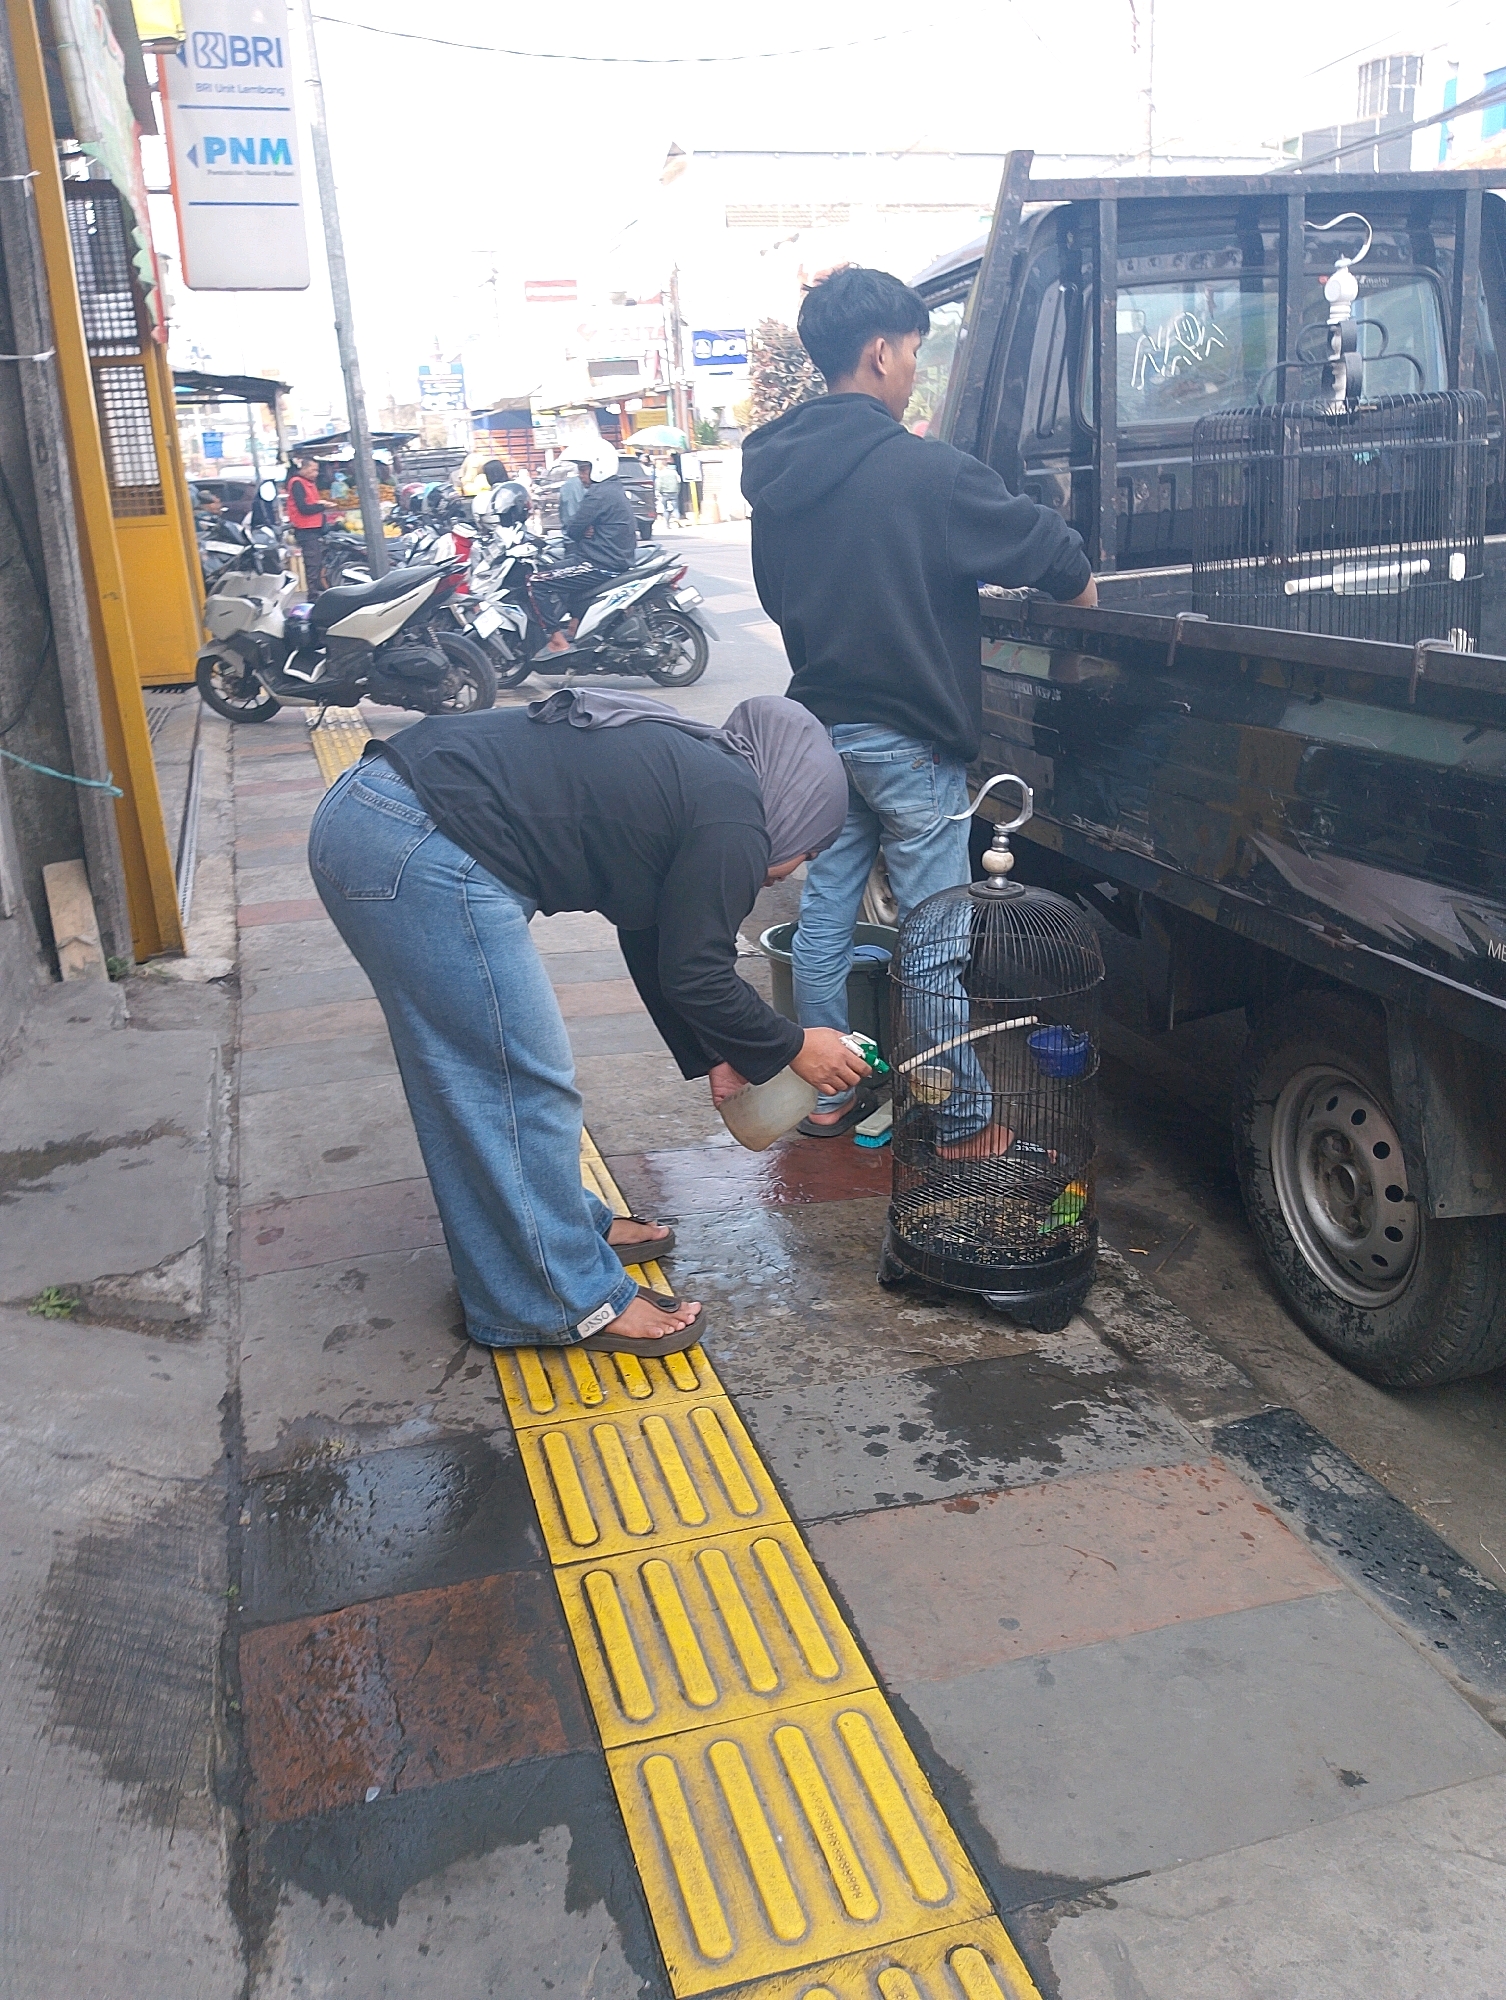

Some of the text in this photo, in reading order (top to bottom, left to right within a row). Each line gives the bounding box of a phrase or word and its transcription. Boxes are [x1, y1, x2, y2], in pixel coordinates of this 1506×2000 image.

[229, 35, 283, 68] BRI
[195, 83, 285, 96] BRI Unit Lembang
[203, 136, 293, 165] PNM
